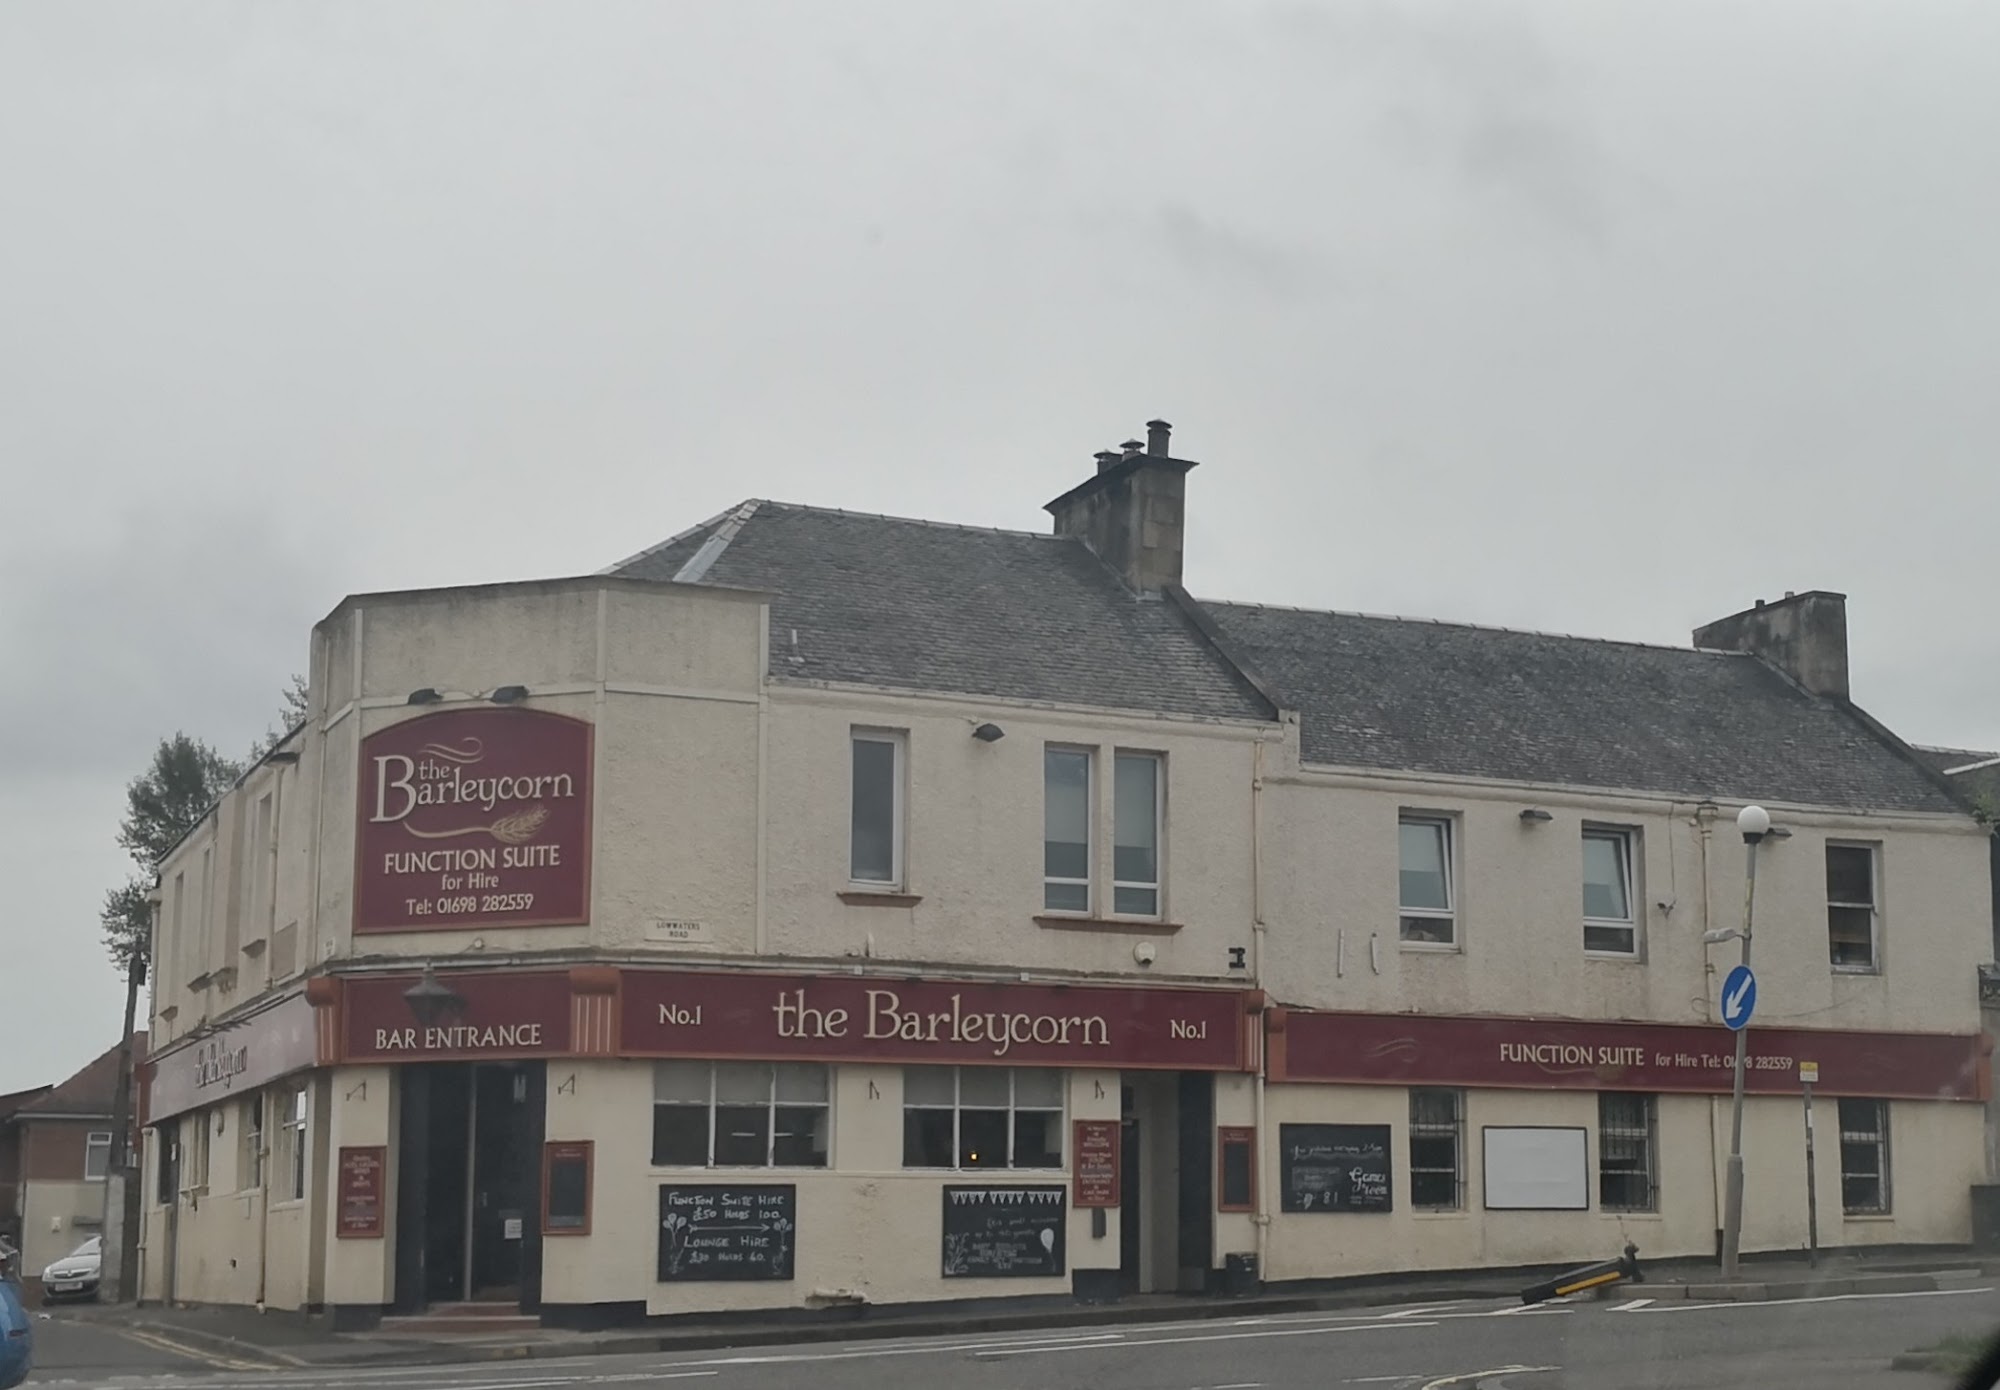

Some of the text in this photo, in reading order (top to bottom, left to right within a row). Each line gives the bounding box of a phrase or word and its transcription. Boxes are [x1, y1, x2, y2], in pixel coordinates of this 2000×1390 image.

[418, 758, 450, 780] the
[369, 755, 575, 823] Barleycorn
[383, 845, 561, 874] FUNCTION SUITE
[441, 872, 499, 891] for Hire
[405, 893, 534, 916] Tel: 01698 282559
[669, 930, 689, 938] ROAD
[772, 989, 1111, 1057] the Barleycorn
[375, 1024, 542, 1050] BAR ENTRANCE
[1499, 1043, 1793, 1070] FUNCTION SUITE for Hire Tel: 018 282559
